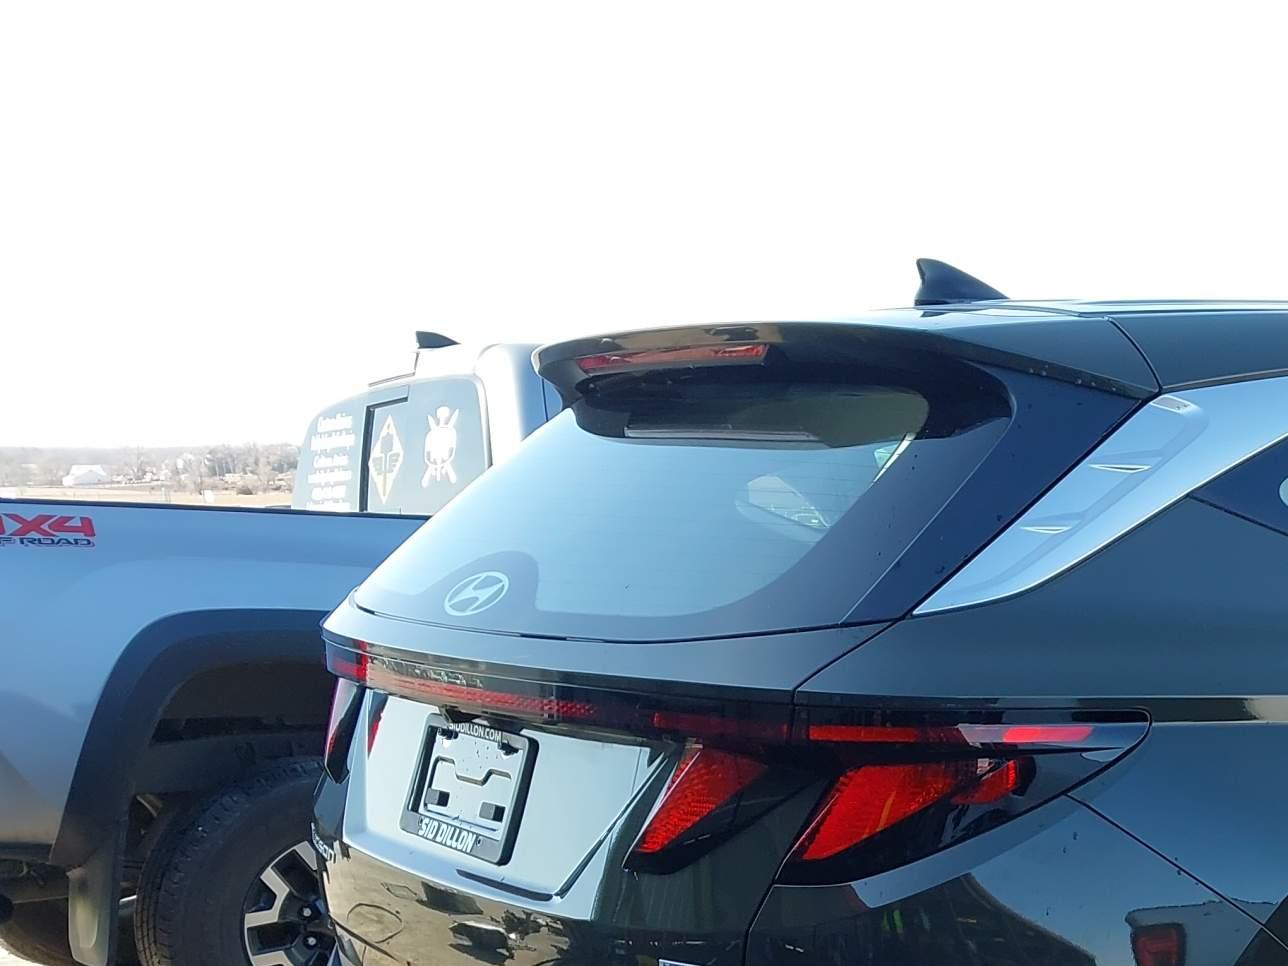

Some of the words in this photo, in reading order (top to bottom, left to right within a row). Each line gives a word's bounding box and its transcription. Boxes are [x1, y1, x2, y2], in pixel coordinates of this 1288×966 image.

[0, 513, 96, 537] X4
[20, 537, 95, 547] ROAD
[449, 723, 502, 742] SIDDILLON.COM
[418, 817, 440, 840] SID
[435, 822, 477, 853] DILLON
